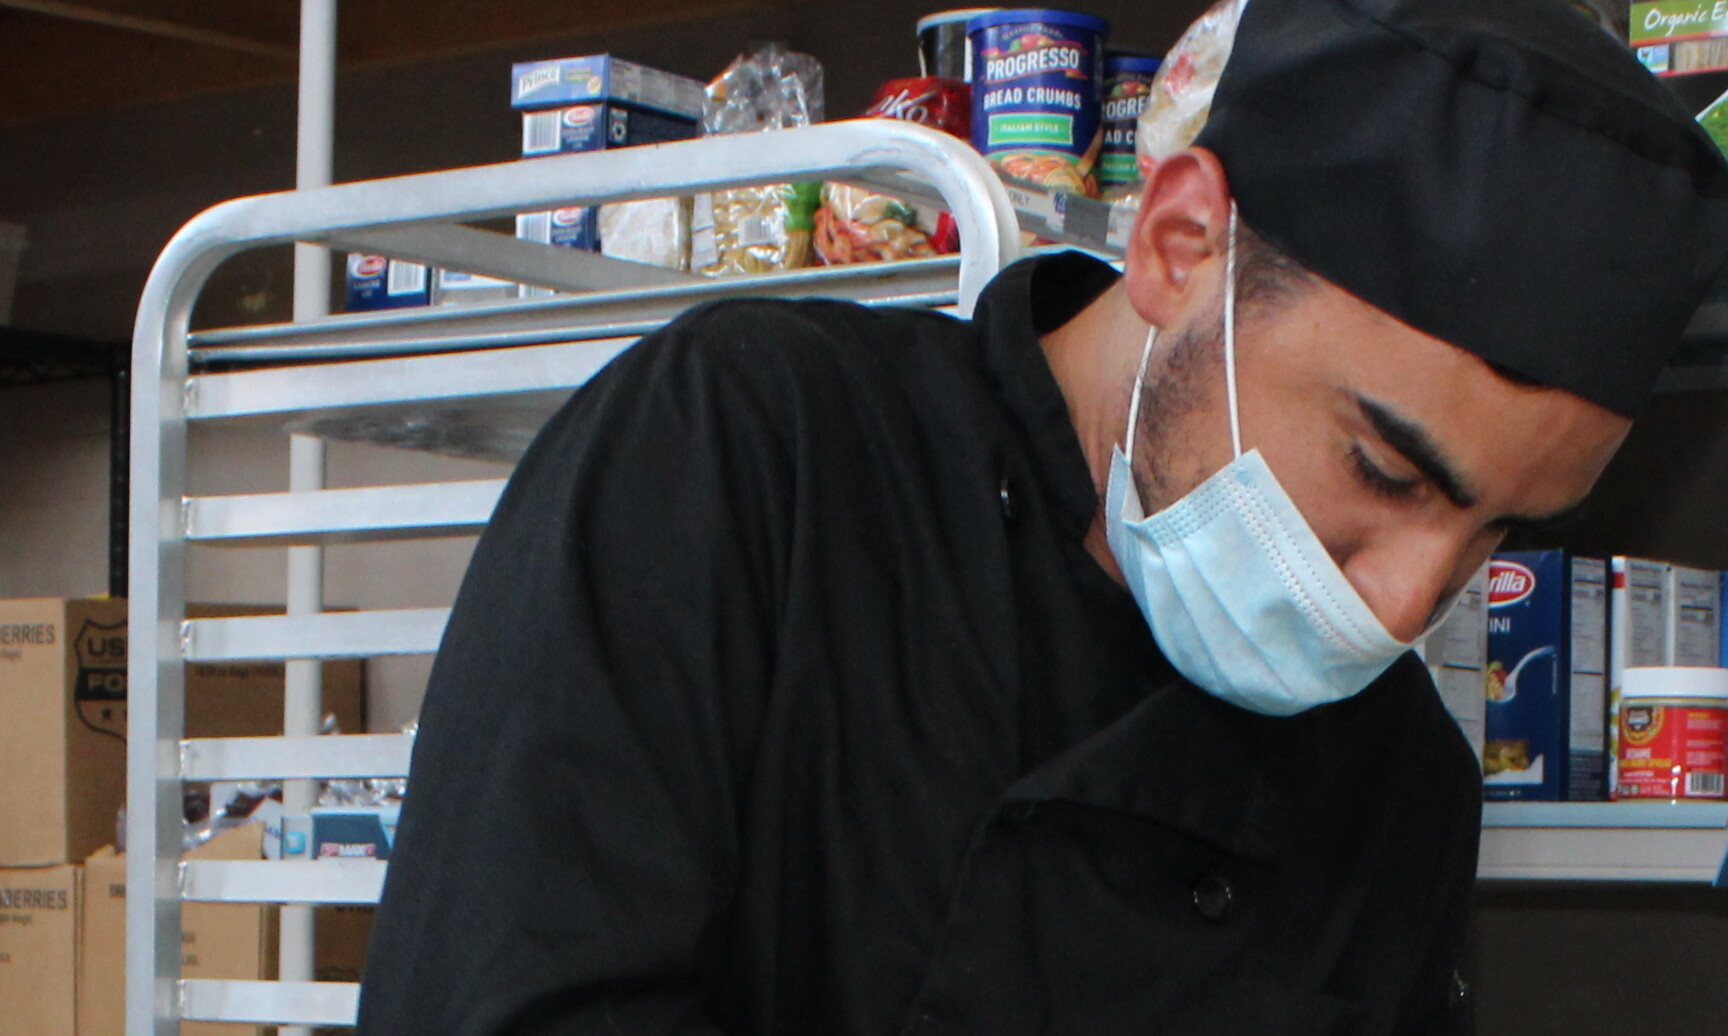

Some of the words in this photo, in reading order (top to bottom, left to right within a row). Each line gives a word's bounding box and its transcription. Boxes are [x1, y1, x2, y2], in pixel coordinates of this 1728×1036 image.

[1642, 4, 1708, 37] Organic
[985, 47, 1081, 80] PROGRESSO
[522, 67, 557, 91] Prince
[983, 88, 1023, 111] BREAD
[1025, 88, 1082, 111] CRUMBS
